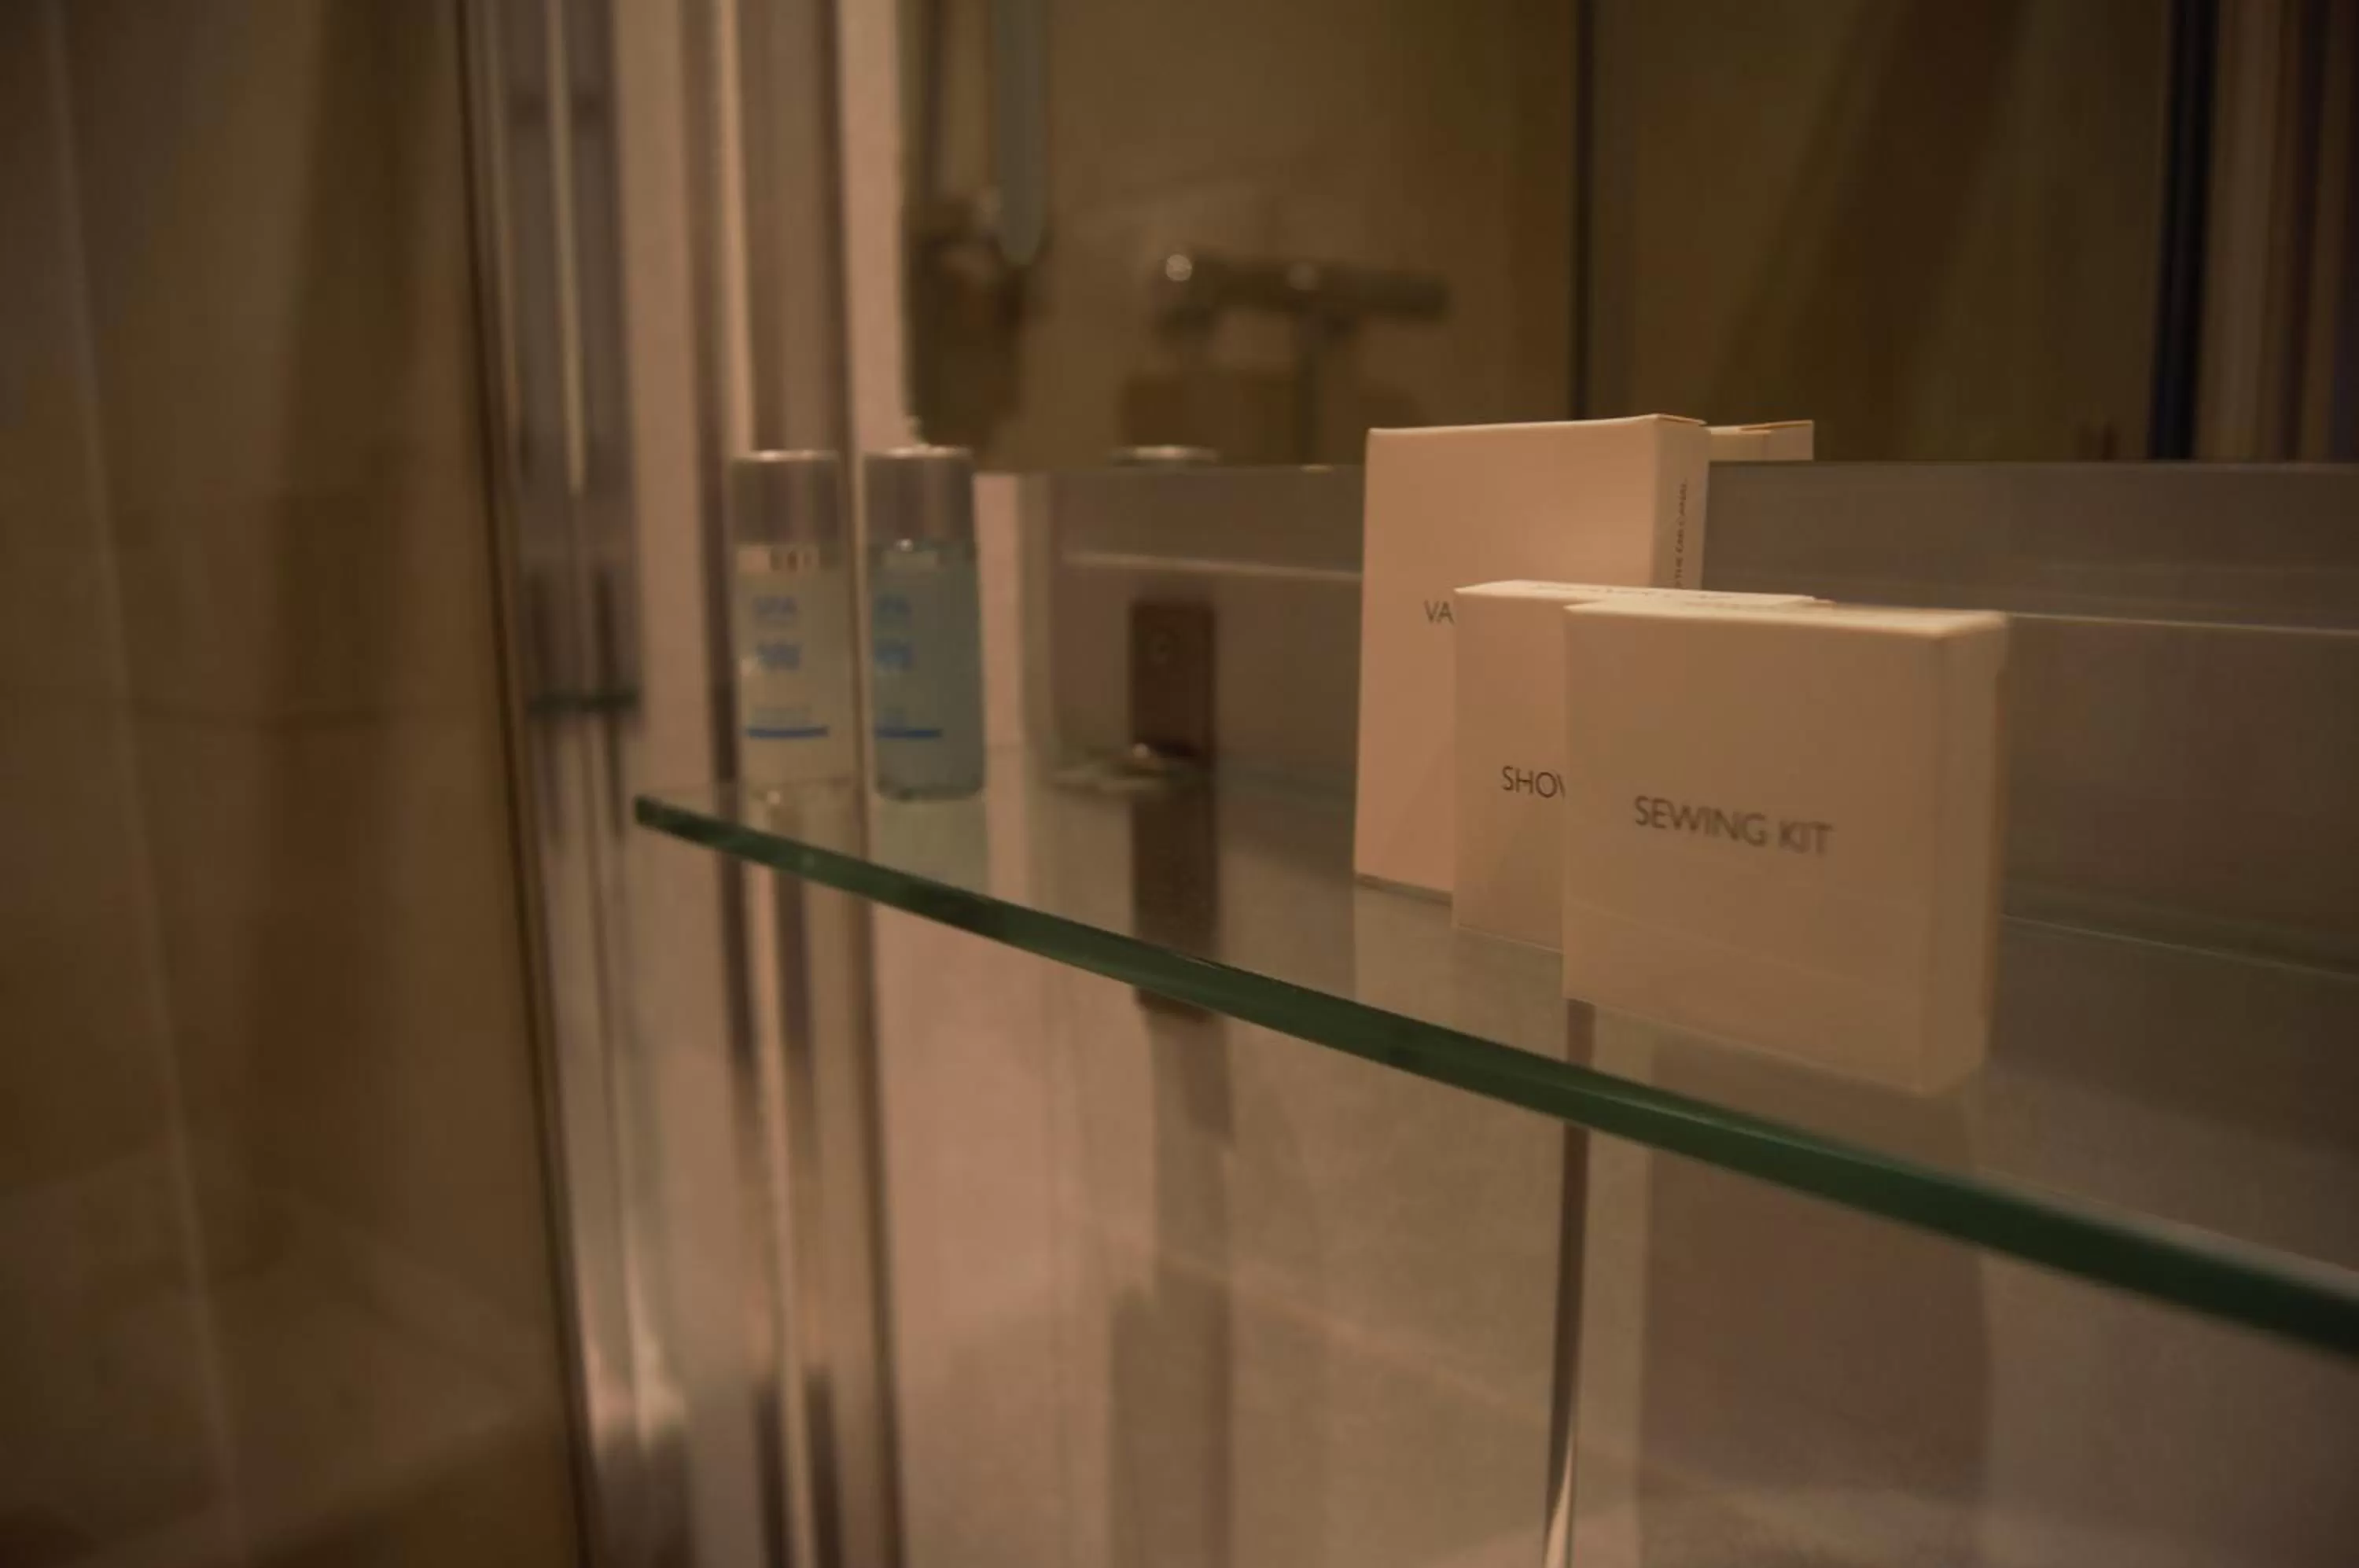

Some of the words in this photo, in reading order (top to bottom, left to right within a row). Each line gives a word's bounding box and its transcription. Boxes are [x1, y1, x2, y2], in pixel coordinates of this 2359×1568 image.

[1423, 600, 1455, 625] VA
[1634, 795, 1768, 848] SEWING
[1778, 819, 1835, 856] KIT
